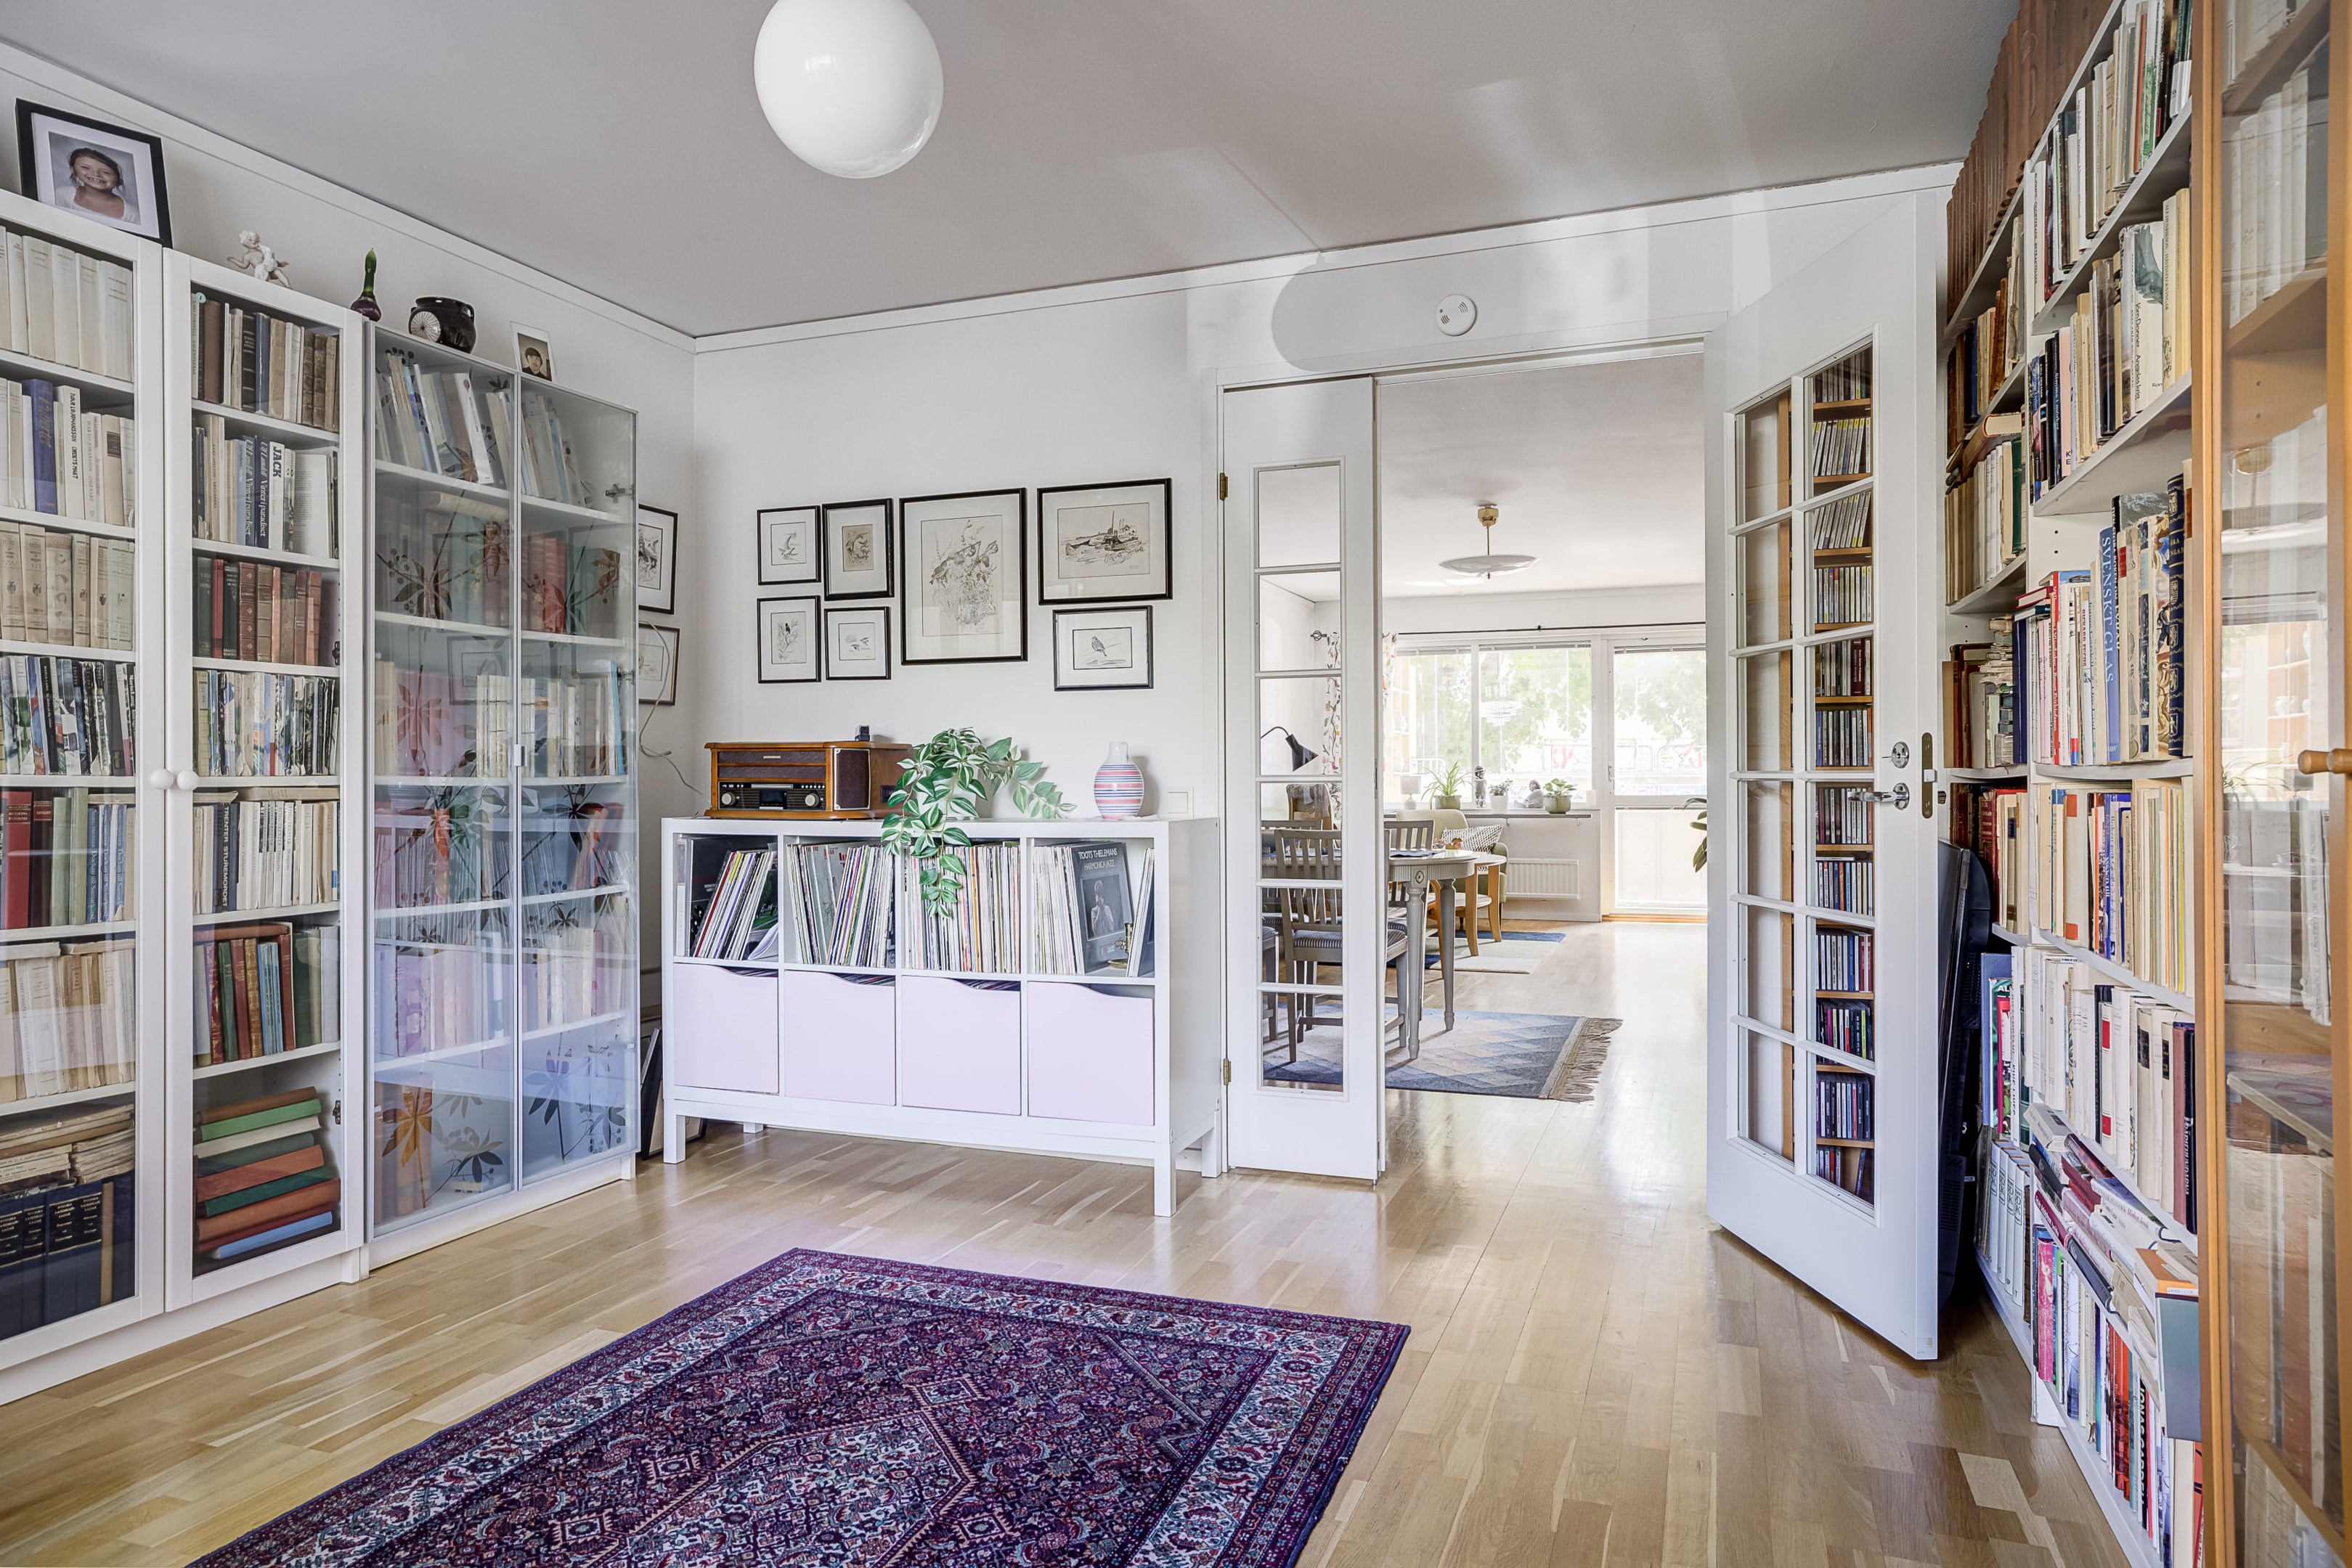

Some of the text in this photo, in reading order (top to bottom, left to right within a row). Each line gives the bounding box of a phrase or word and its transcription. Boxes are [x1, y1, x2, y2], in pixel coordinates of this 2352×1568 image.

[259, 441, 268, 453] Ulf
[272, 446, 282, 478] JACK
[259, 505, 268, 537] paradiset
[2101, 536, 2114, 682] SVENSKT GLAS
[1078, 848, 1118, 859] TOOTS THIELEMANS
[1084, 859, 1115, 870] HARMONICA JAZZ
